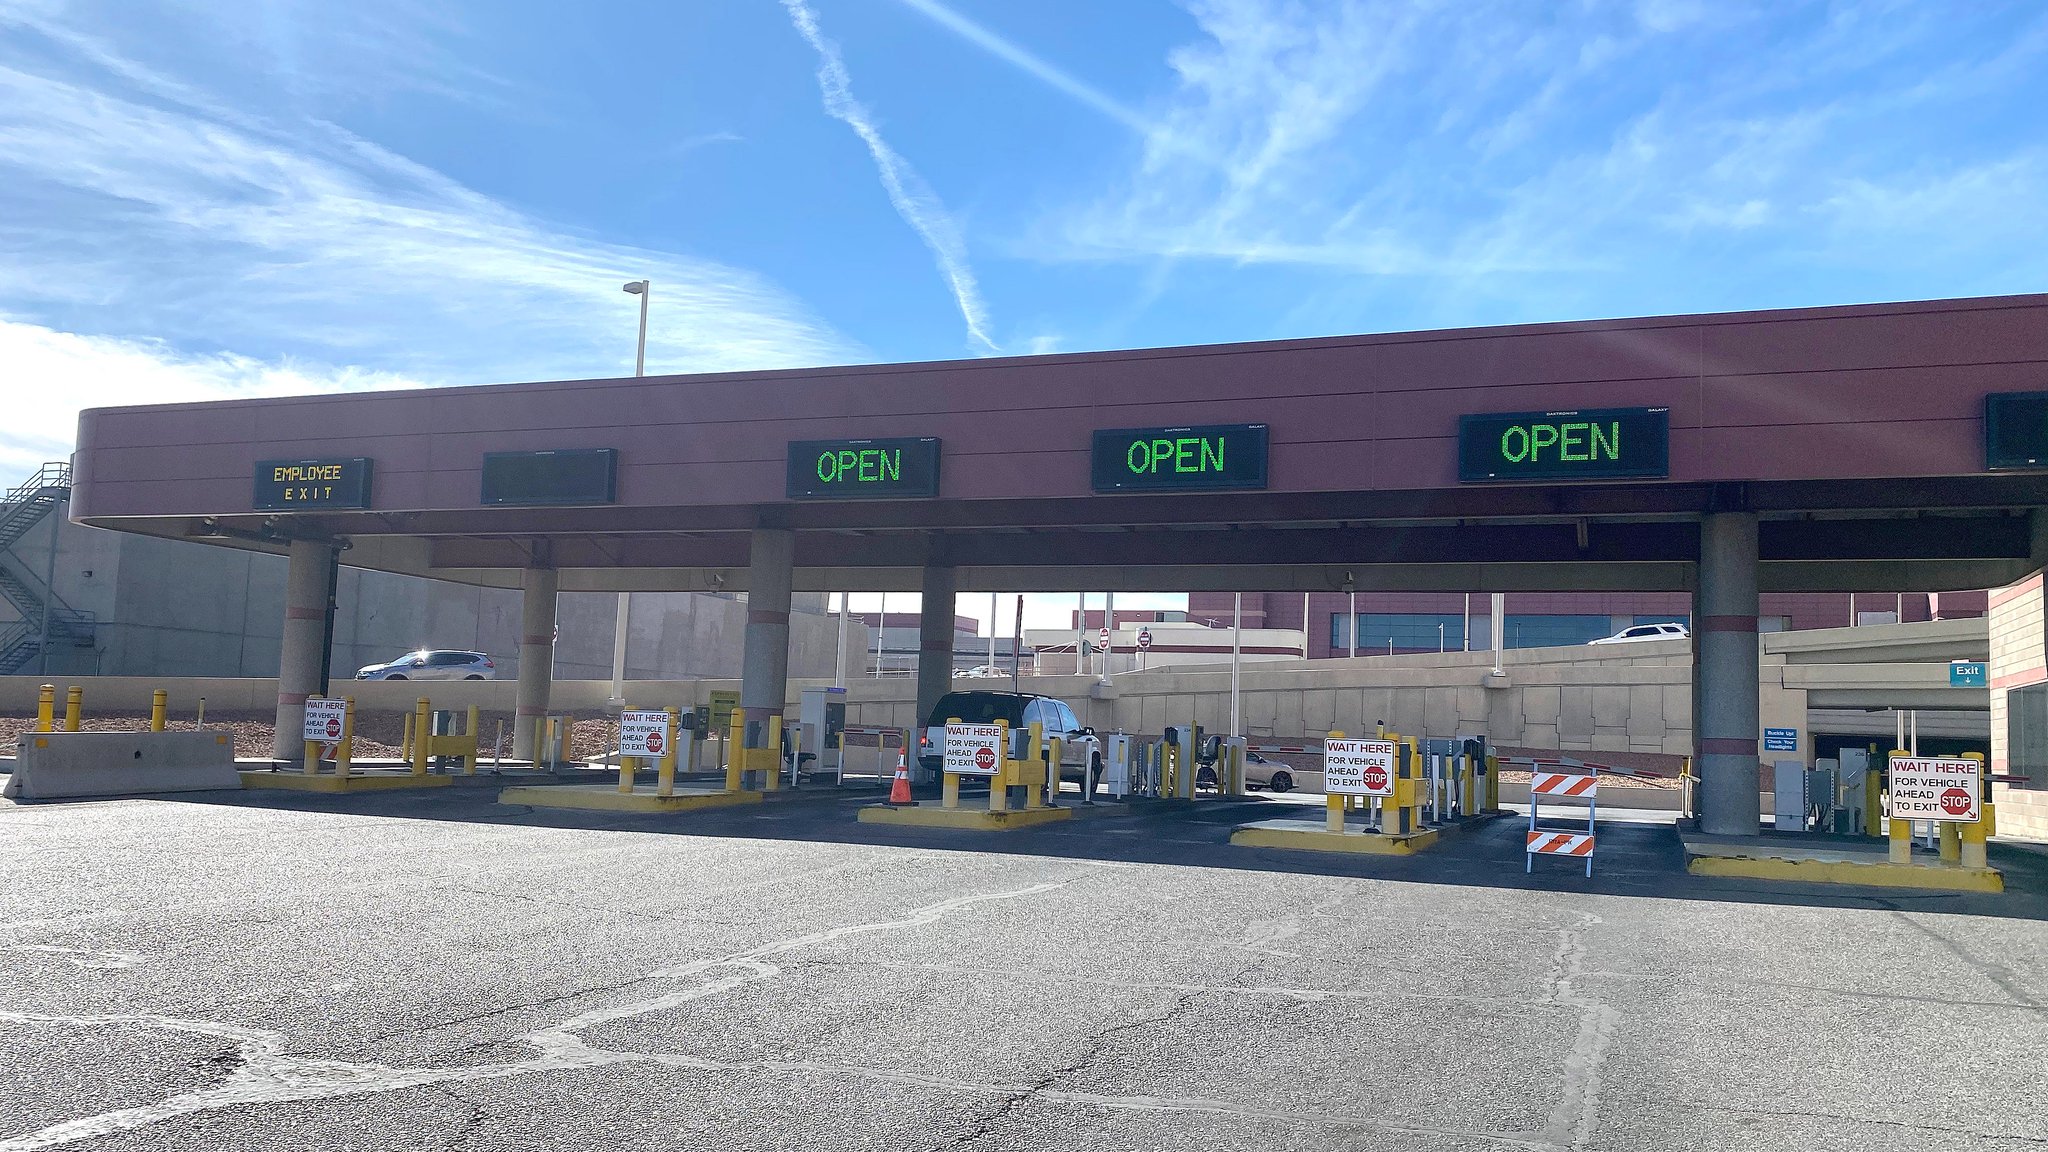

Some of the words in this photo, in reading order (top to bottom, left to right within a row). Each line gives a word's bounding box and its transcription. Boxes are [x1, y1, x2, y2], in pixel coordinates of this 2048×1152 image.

[1502, 421, 1619, 463] OPEN
[1127, 437, 1225, 474] OPEN
[817, 449, 900, 482] OPEN
[274, 465, 341, 481] EMPLOYEE
[285, 487, 331, 499] EXIT
[1956, 666, 1979, 675] Exit
[326, 702, 345, 710] HERE
[645, 714, 667, 722] HERE
[327, 724, 340, 732] STOP
[947, 727, 971, 735] WAIT
[974, 728, 999, 736] HERE
[646, 738, 662, 747] STOP
[1328, 743, 1356, 752] WAIT
[1360, 744, 1391, 754] HERE
[976, 754, 994, 763] STOP
[1348, 758, 1385, 766] VEHICLE
[1893, 761, 1930, 772] WAIT
[1936, 763, 1976, 774] HERE
[1364, 773, 1386, 783] STOP
[1895, 778, 1917, 786] FOR
[1921, 779, 1968, 788] VEHICLE
[1895, 790, 1934, 799] AHEAD
[1942, 796, 1970, 807] STOP
[1895, 802, 1910, 810] TO
[1914, 803, 1939, 811] EXIT
